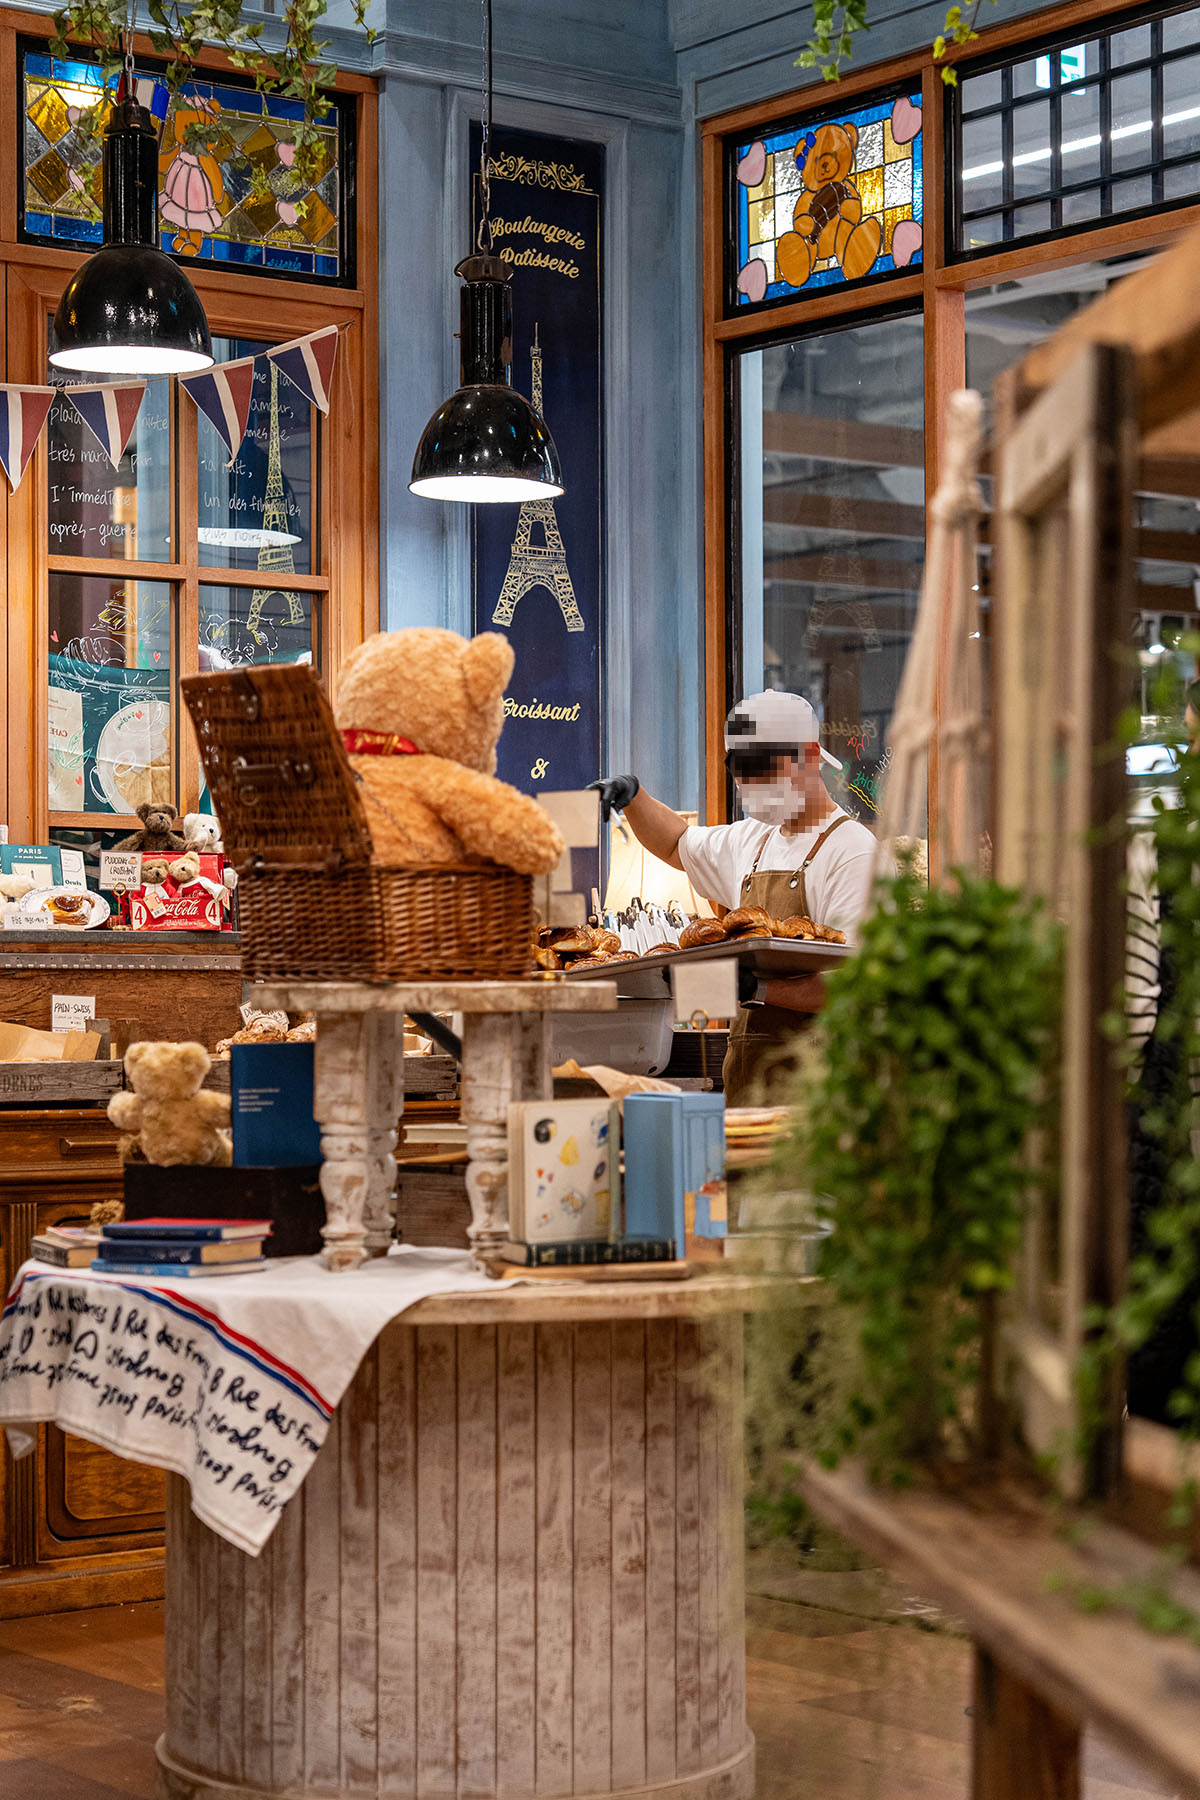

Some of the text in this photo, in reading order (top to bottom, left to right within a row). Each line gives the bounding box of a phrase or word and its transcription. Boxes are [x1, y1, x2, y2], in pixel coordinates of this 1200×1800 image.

[490, 216, 585, 250] Boulangerie
[500, 247, 580, 279] Patisserie
[48, 440, 76, 462] très
[501, 696, 581, 721] Croissant
[530, 758, 550, 779] &
[134, 905, 143, 923] 4
[164, 899, 200, 916] ca-Cola
[207, 902, 217, 922] 4
